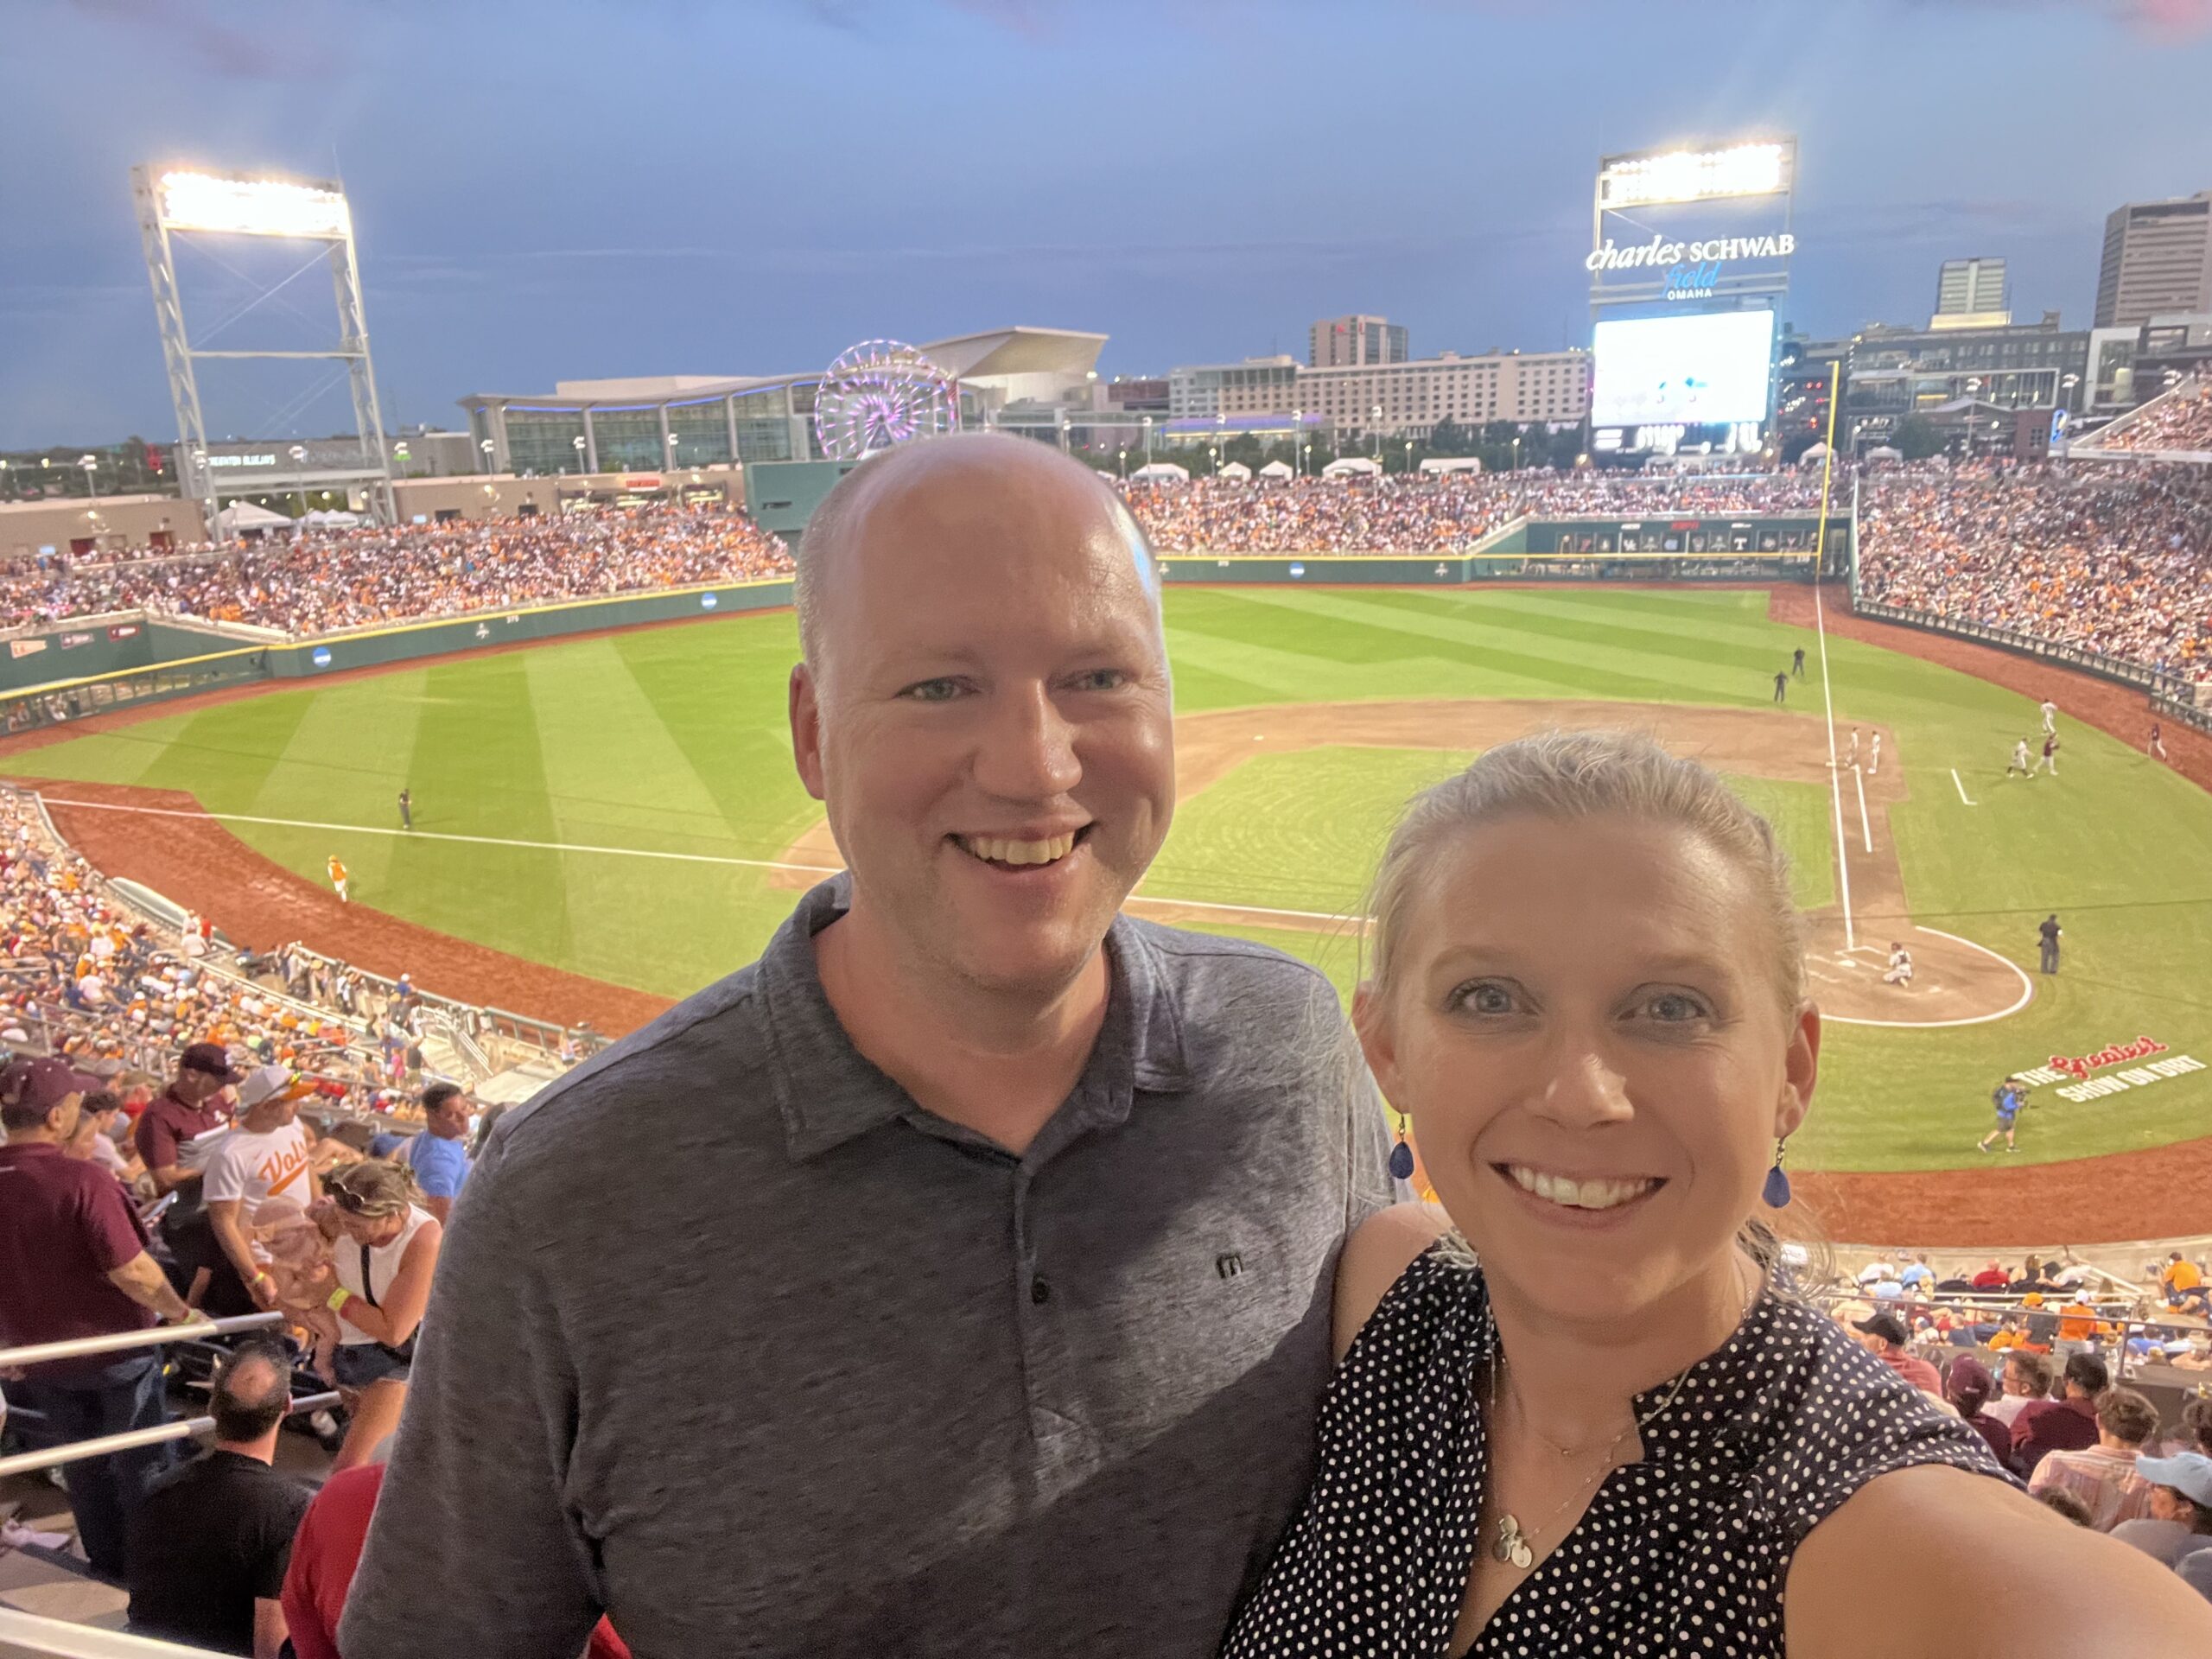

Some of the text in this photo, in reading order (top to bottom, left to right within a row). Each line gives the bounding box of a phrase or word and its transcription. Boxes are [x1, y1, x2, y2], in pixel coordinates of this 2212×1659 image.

[1586, 233, 1795, 270] charles SCHWAB
[1660, 261, 1722, 299] field
[1667, 288, 1713, 301] OMAHA
[2011, 1065, 2068, 1087] THE
[2055, 1054, 2208, 1103] SHOW ON DIRT
